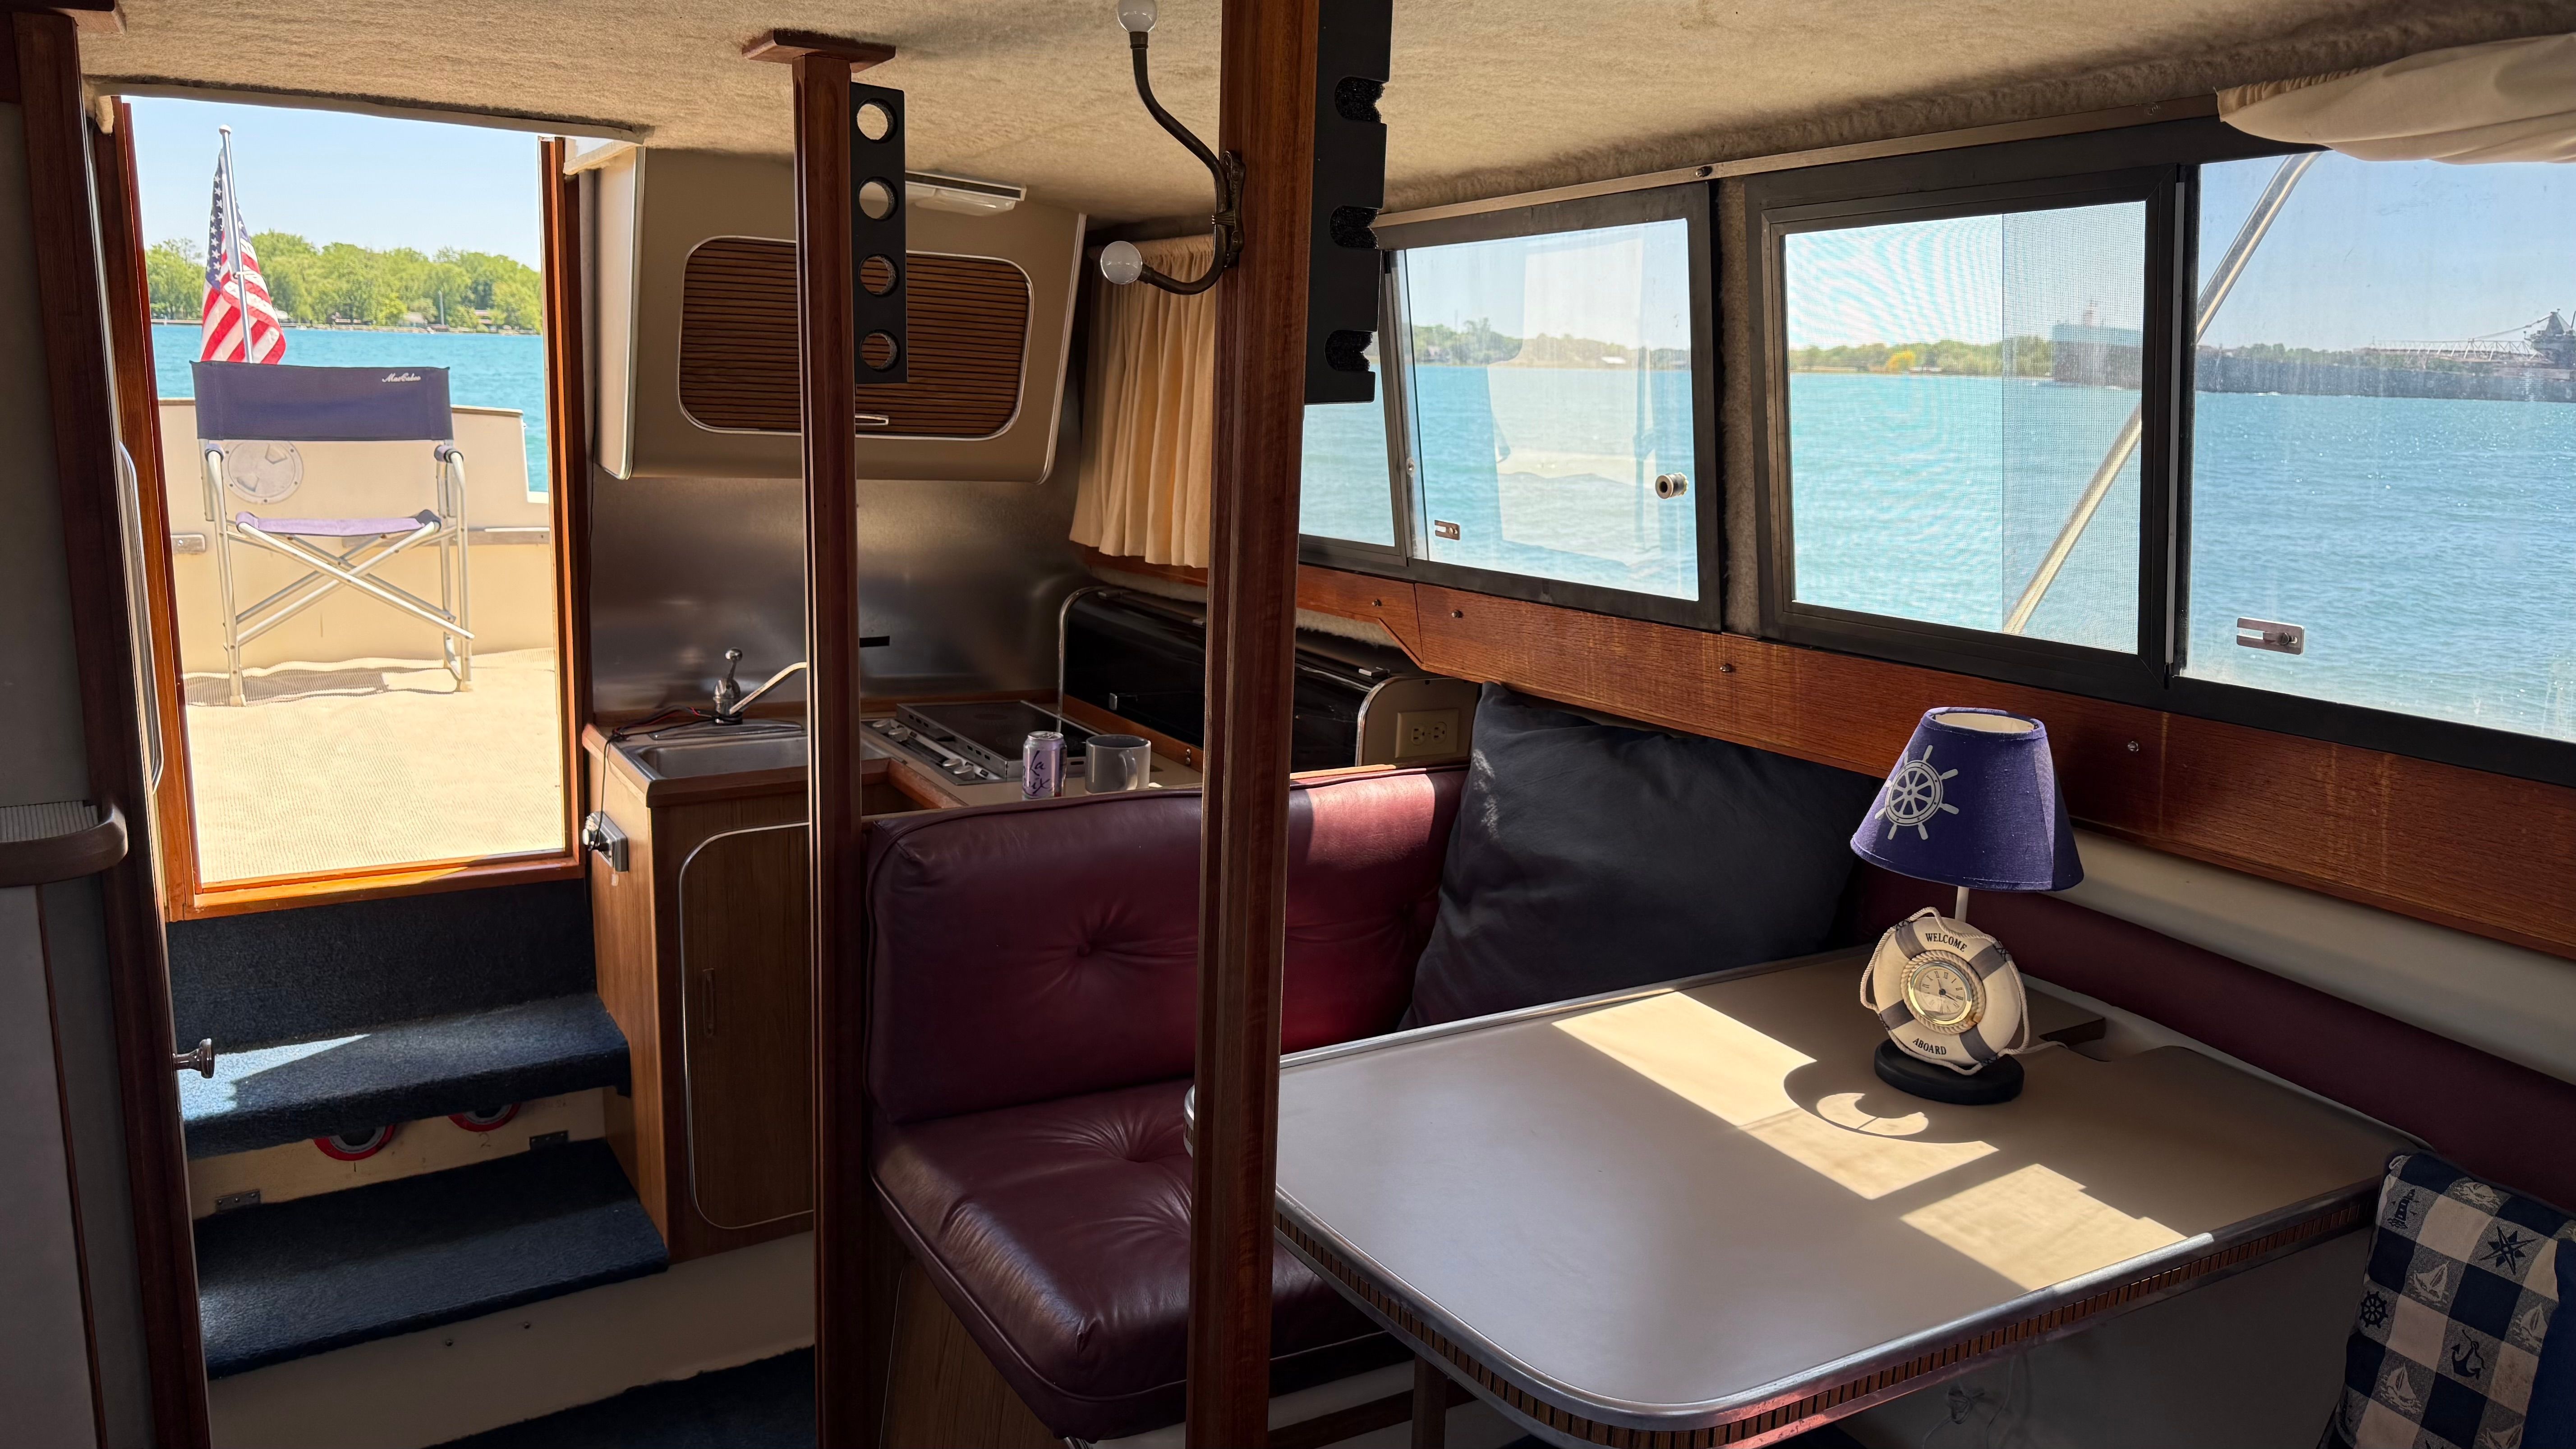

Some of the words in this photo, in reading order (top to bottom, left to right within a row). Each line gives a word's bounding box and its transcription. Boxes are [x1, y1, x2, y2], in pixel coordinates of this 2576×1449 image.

[1029, 750, 1046, 776] La
[1925, 933, 1967, 952] WELCOME
[1912, 1038, 1946, 1055] ABOARD
